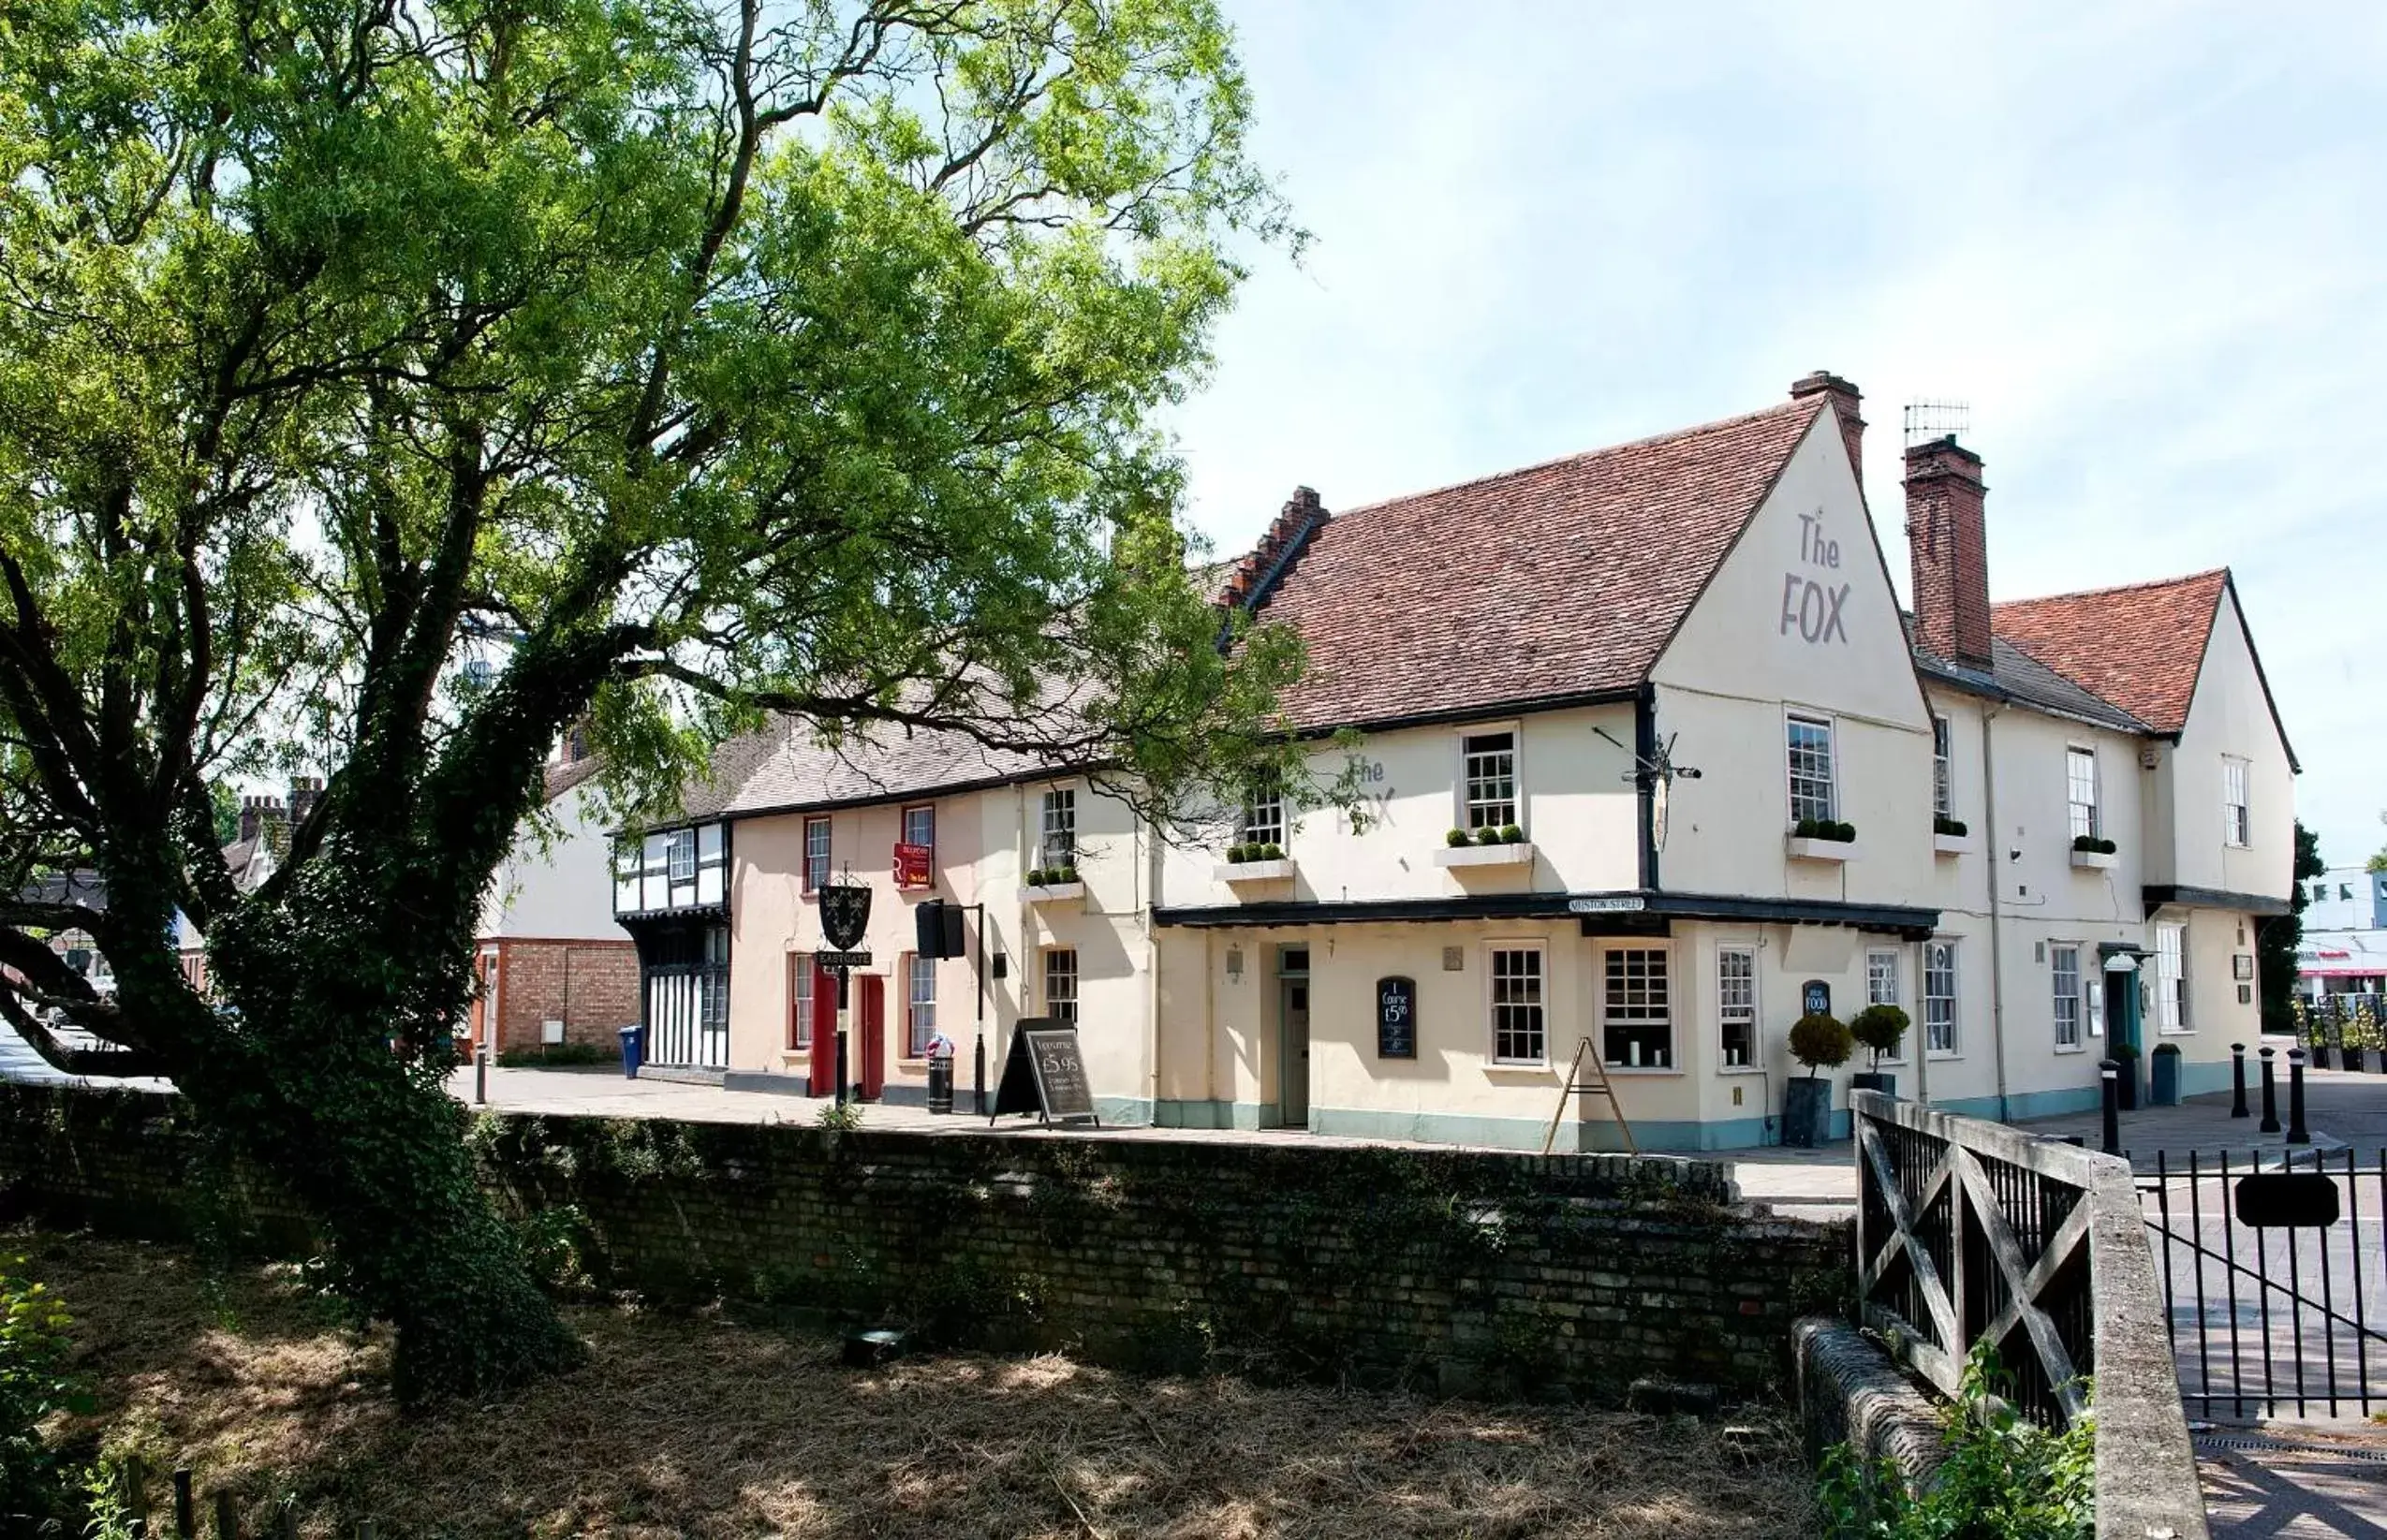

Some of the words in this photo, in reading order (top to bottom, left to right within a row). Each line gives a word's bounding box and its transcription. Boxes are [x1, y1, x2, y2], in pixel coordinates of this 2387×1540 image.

[1798, 514, 1839, 568] The
[1780, 572, 1850, 644] FOX
[1344, 753, 1384, 783] The
[1610, 897, 1643, 909] STREET
[818, 953, 871, 963] EASTGATE
